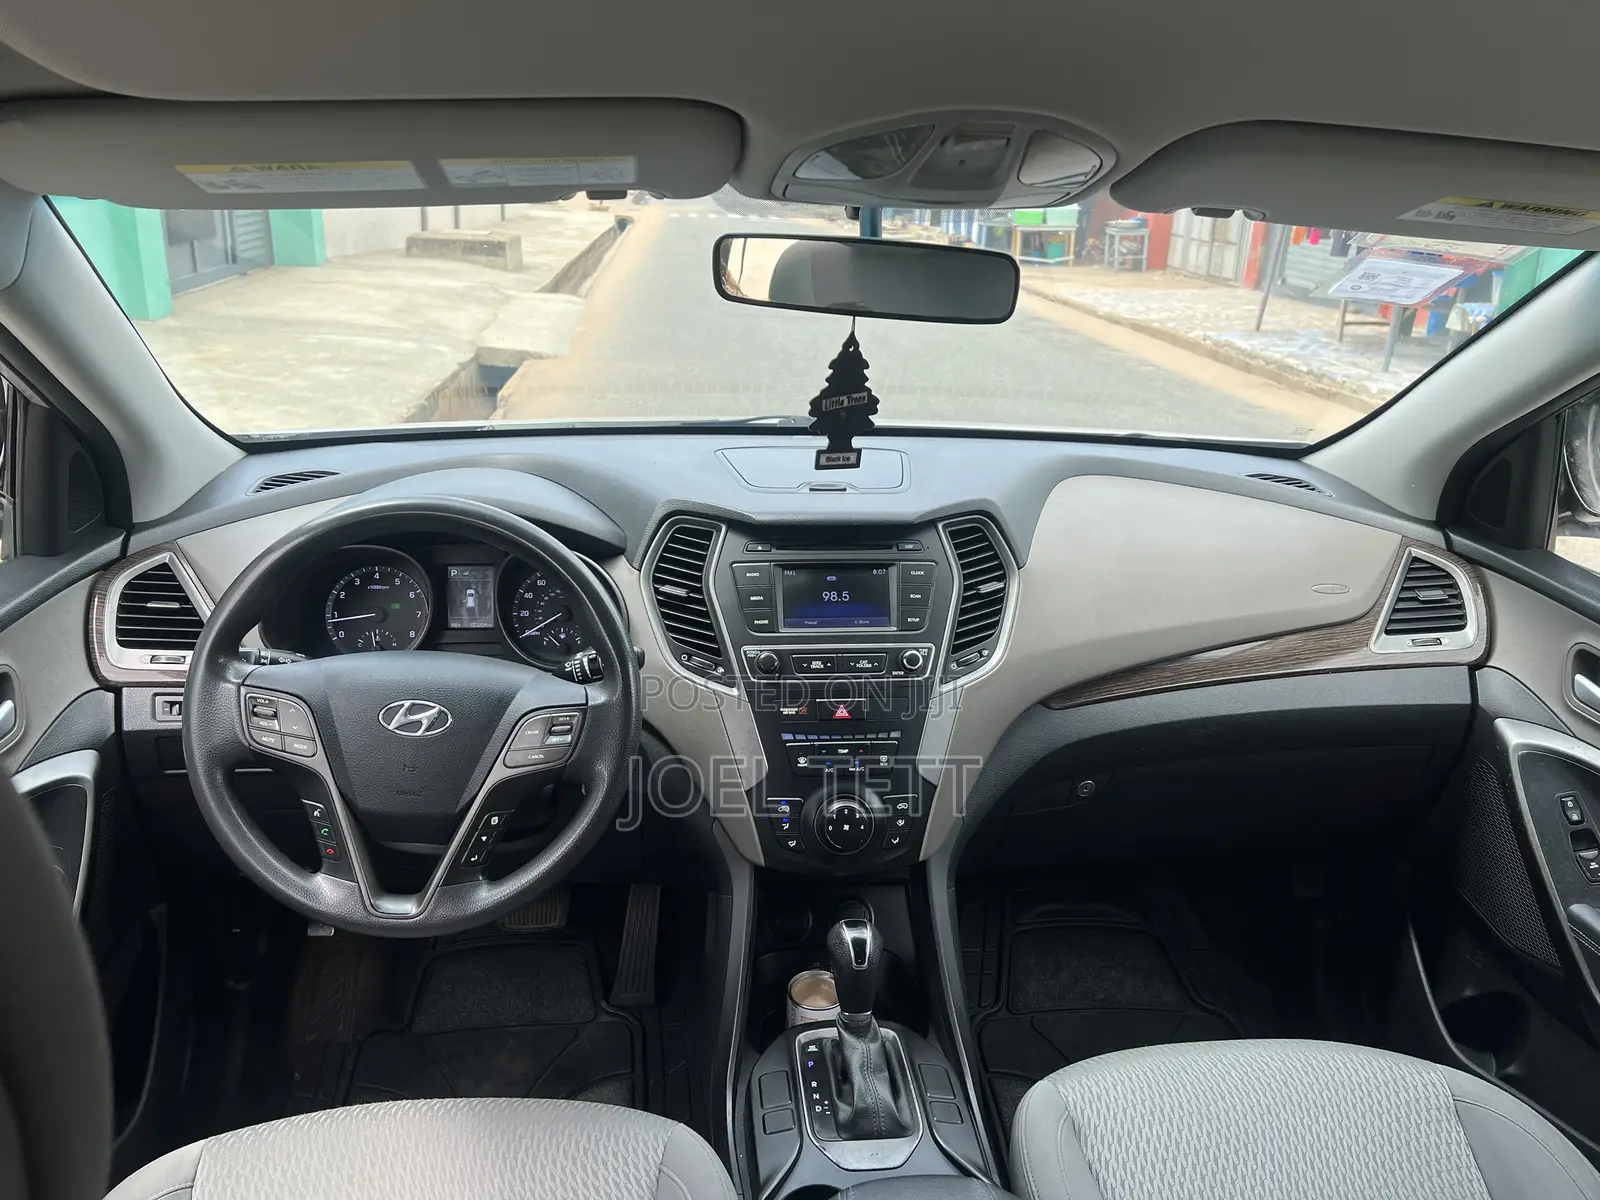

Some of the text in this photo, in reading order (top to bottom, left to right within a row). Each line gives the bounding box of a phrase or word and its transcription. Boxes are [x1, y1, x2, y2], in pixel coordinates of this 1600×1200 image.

[824, 394, 866, 410] Little Trees
[822, 591, 849, 602] 98.5
